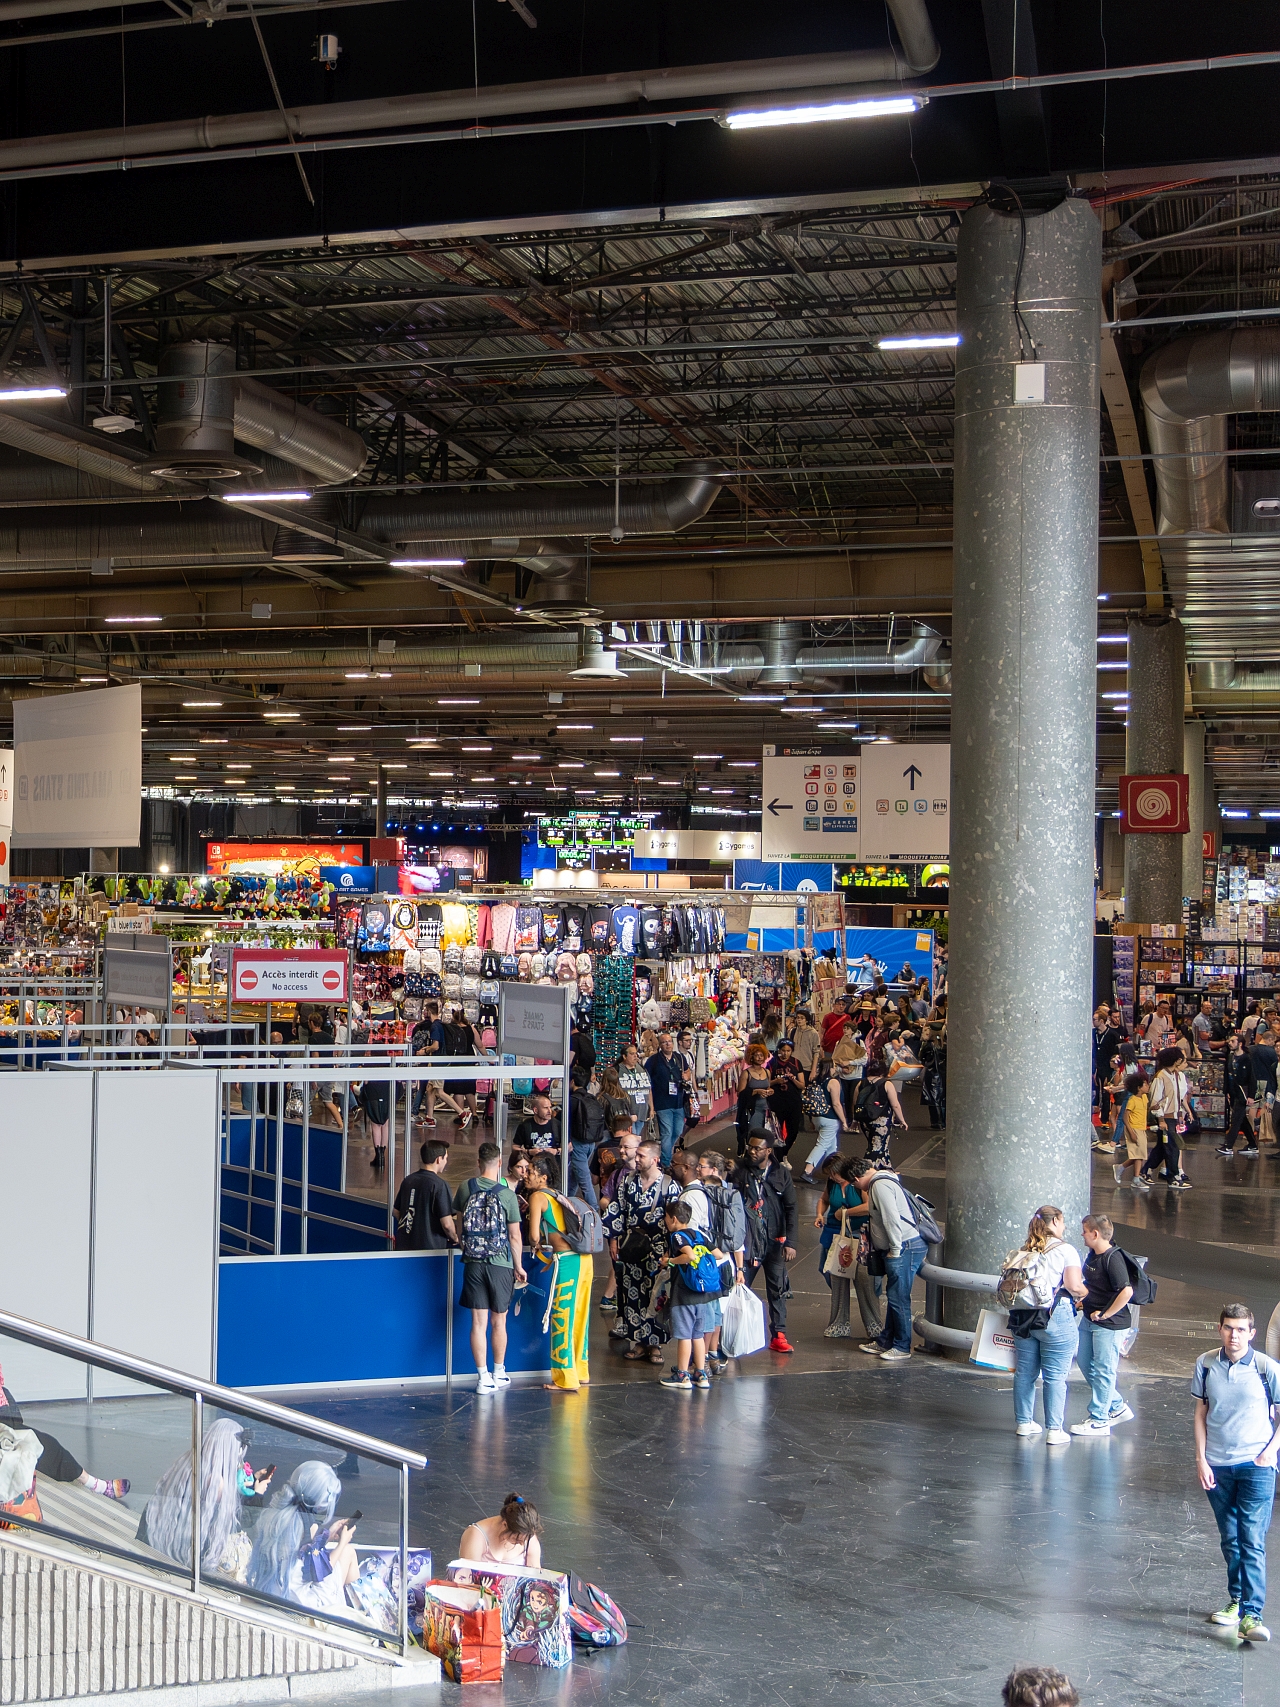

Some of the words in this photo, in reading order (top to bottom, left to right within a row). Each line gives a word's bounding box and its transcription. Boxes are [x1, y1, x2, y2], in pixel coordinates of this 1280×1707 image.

[118, 920, 129, 930] blue
[132, 920, 143, 929] star
[261, 969, 287, 979] Accès
[289, 970, 319, 979] interdit
[272, 983, 282, 991] No
[283, 983, 308, 991] access
[995, 1336, 1016, 1346] BANDA
